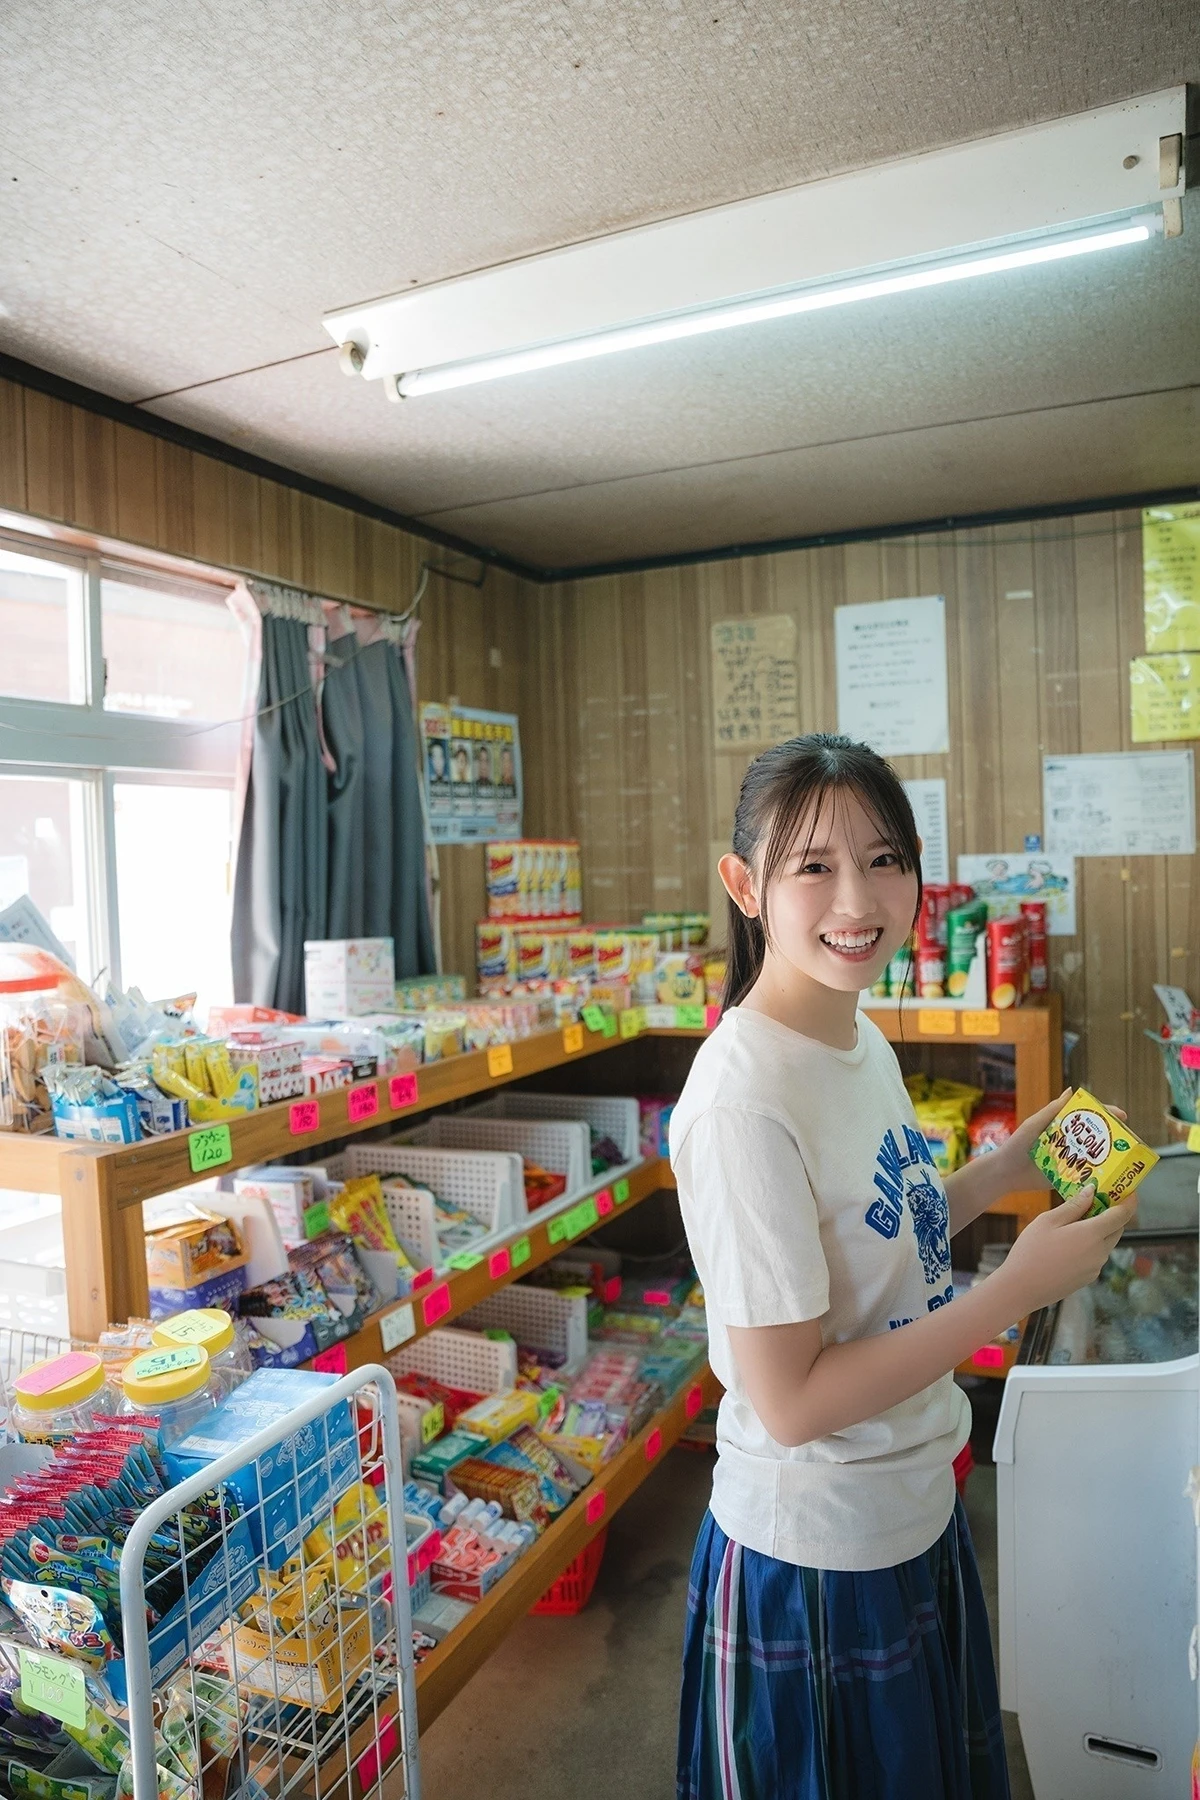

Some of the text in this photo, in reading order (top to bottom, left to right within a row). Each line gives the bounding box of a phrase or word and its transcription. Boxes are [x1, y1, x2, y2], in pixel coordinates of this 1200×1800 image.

[194, 1131, 225, 1149] ブラウニー
[1065, 1113, 1107, 1159] きのこの山
[1109, 1160, 1145, 1202] きのこの山
